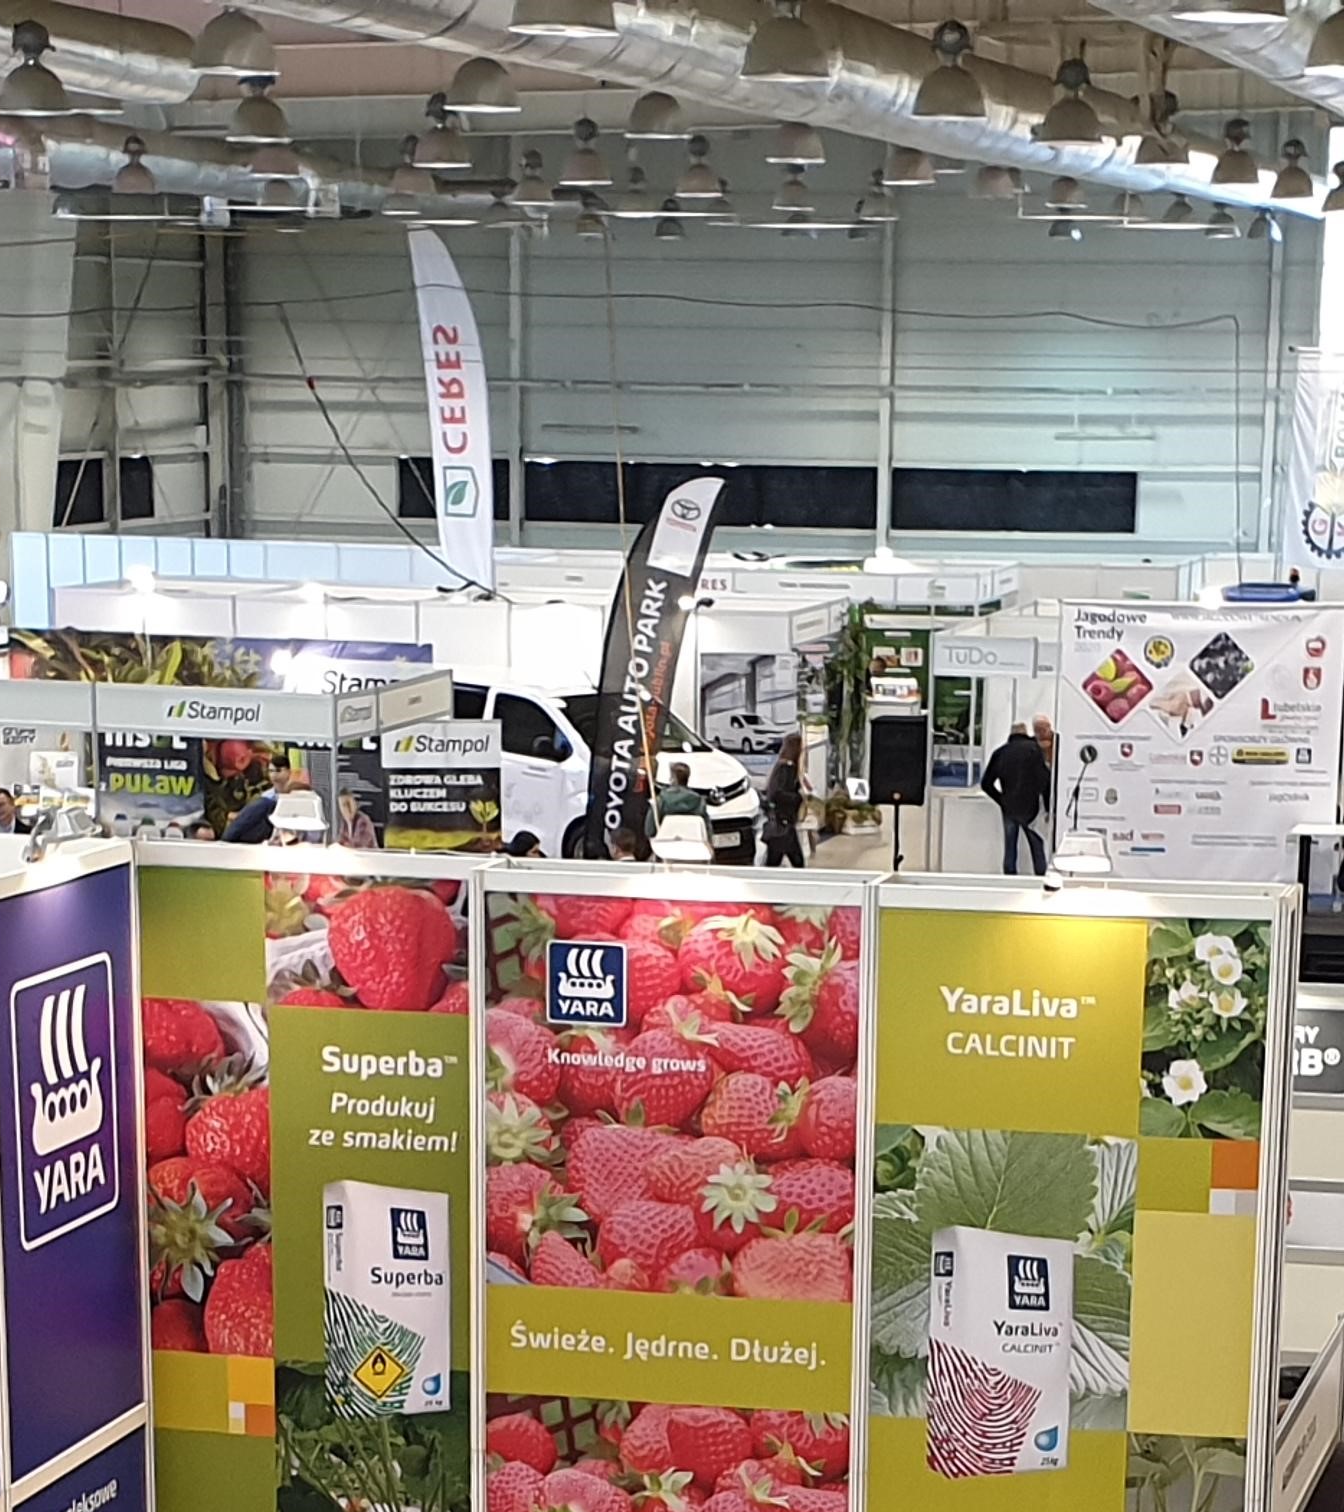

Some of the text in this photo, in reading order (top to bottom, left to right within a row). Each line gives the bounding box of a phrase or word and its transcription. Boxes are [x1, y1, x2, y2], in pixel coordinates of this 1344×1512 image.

[1074, 625, 1124, 642] Trendy
[187, 700, 261, 725] Stampol
[603, 576, 668, 834] OYOTA AUTO PARK
[414, 735, 490, 756] Stampol
[558, 998, 614, 1018] YARA
[946, 1032, 1076, 1060] CALCINIT
[547, 1047, 707, 1075] Knowledge grows
[330, 1092, 436, 1124] Produkuj
[307, 1127, 458, 1153] ze smakiem!
[33, 1143, 106, 1215] YARA
[371, 1267, 444, 1288] Superba
[510, 1323, 827, 1367] Świeże. Jędrne. Dłużej.
